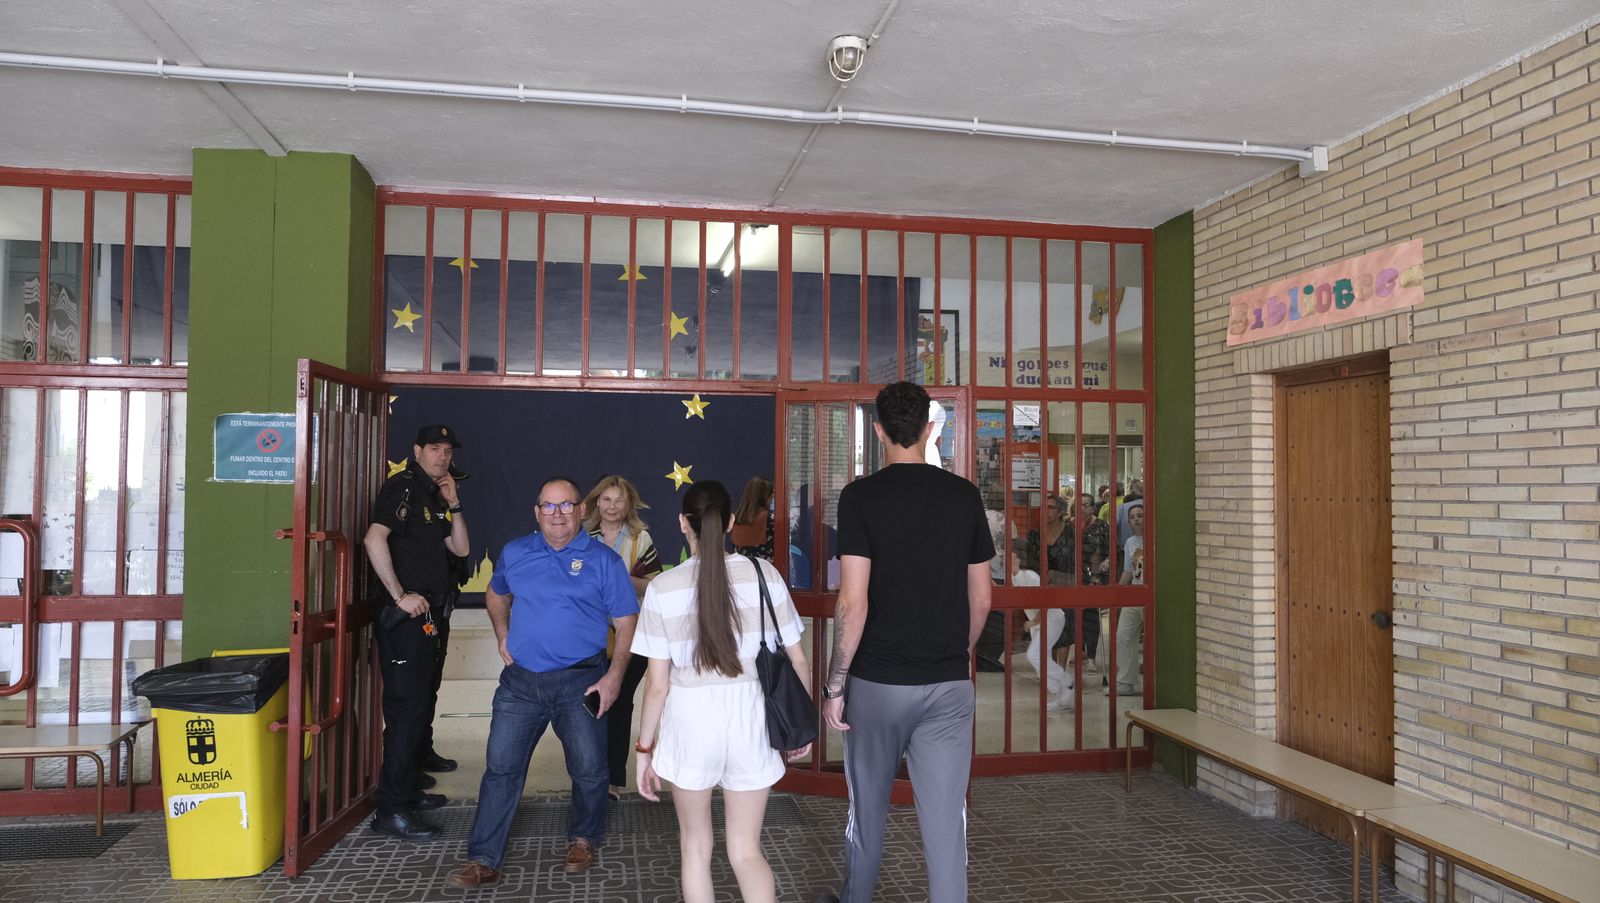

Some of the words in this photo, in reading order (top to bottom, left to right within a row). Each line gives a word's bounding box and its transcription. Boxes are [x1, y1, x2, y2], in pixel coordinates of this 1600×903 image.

[230, 419, 242, 427] ESTÁ
[242, 420, 285, 428] TERMINANTEMENTE
[230, 455, 245, 463] FUMAR
[248, 469, 268, 477] INCLUIDO
[177, 768, 232, 783] ALMERÍA
[190, 782, 219, 790] CIUDAD
